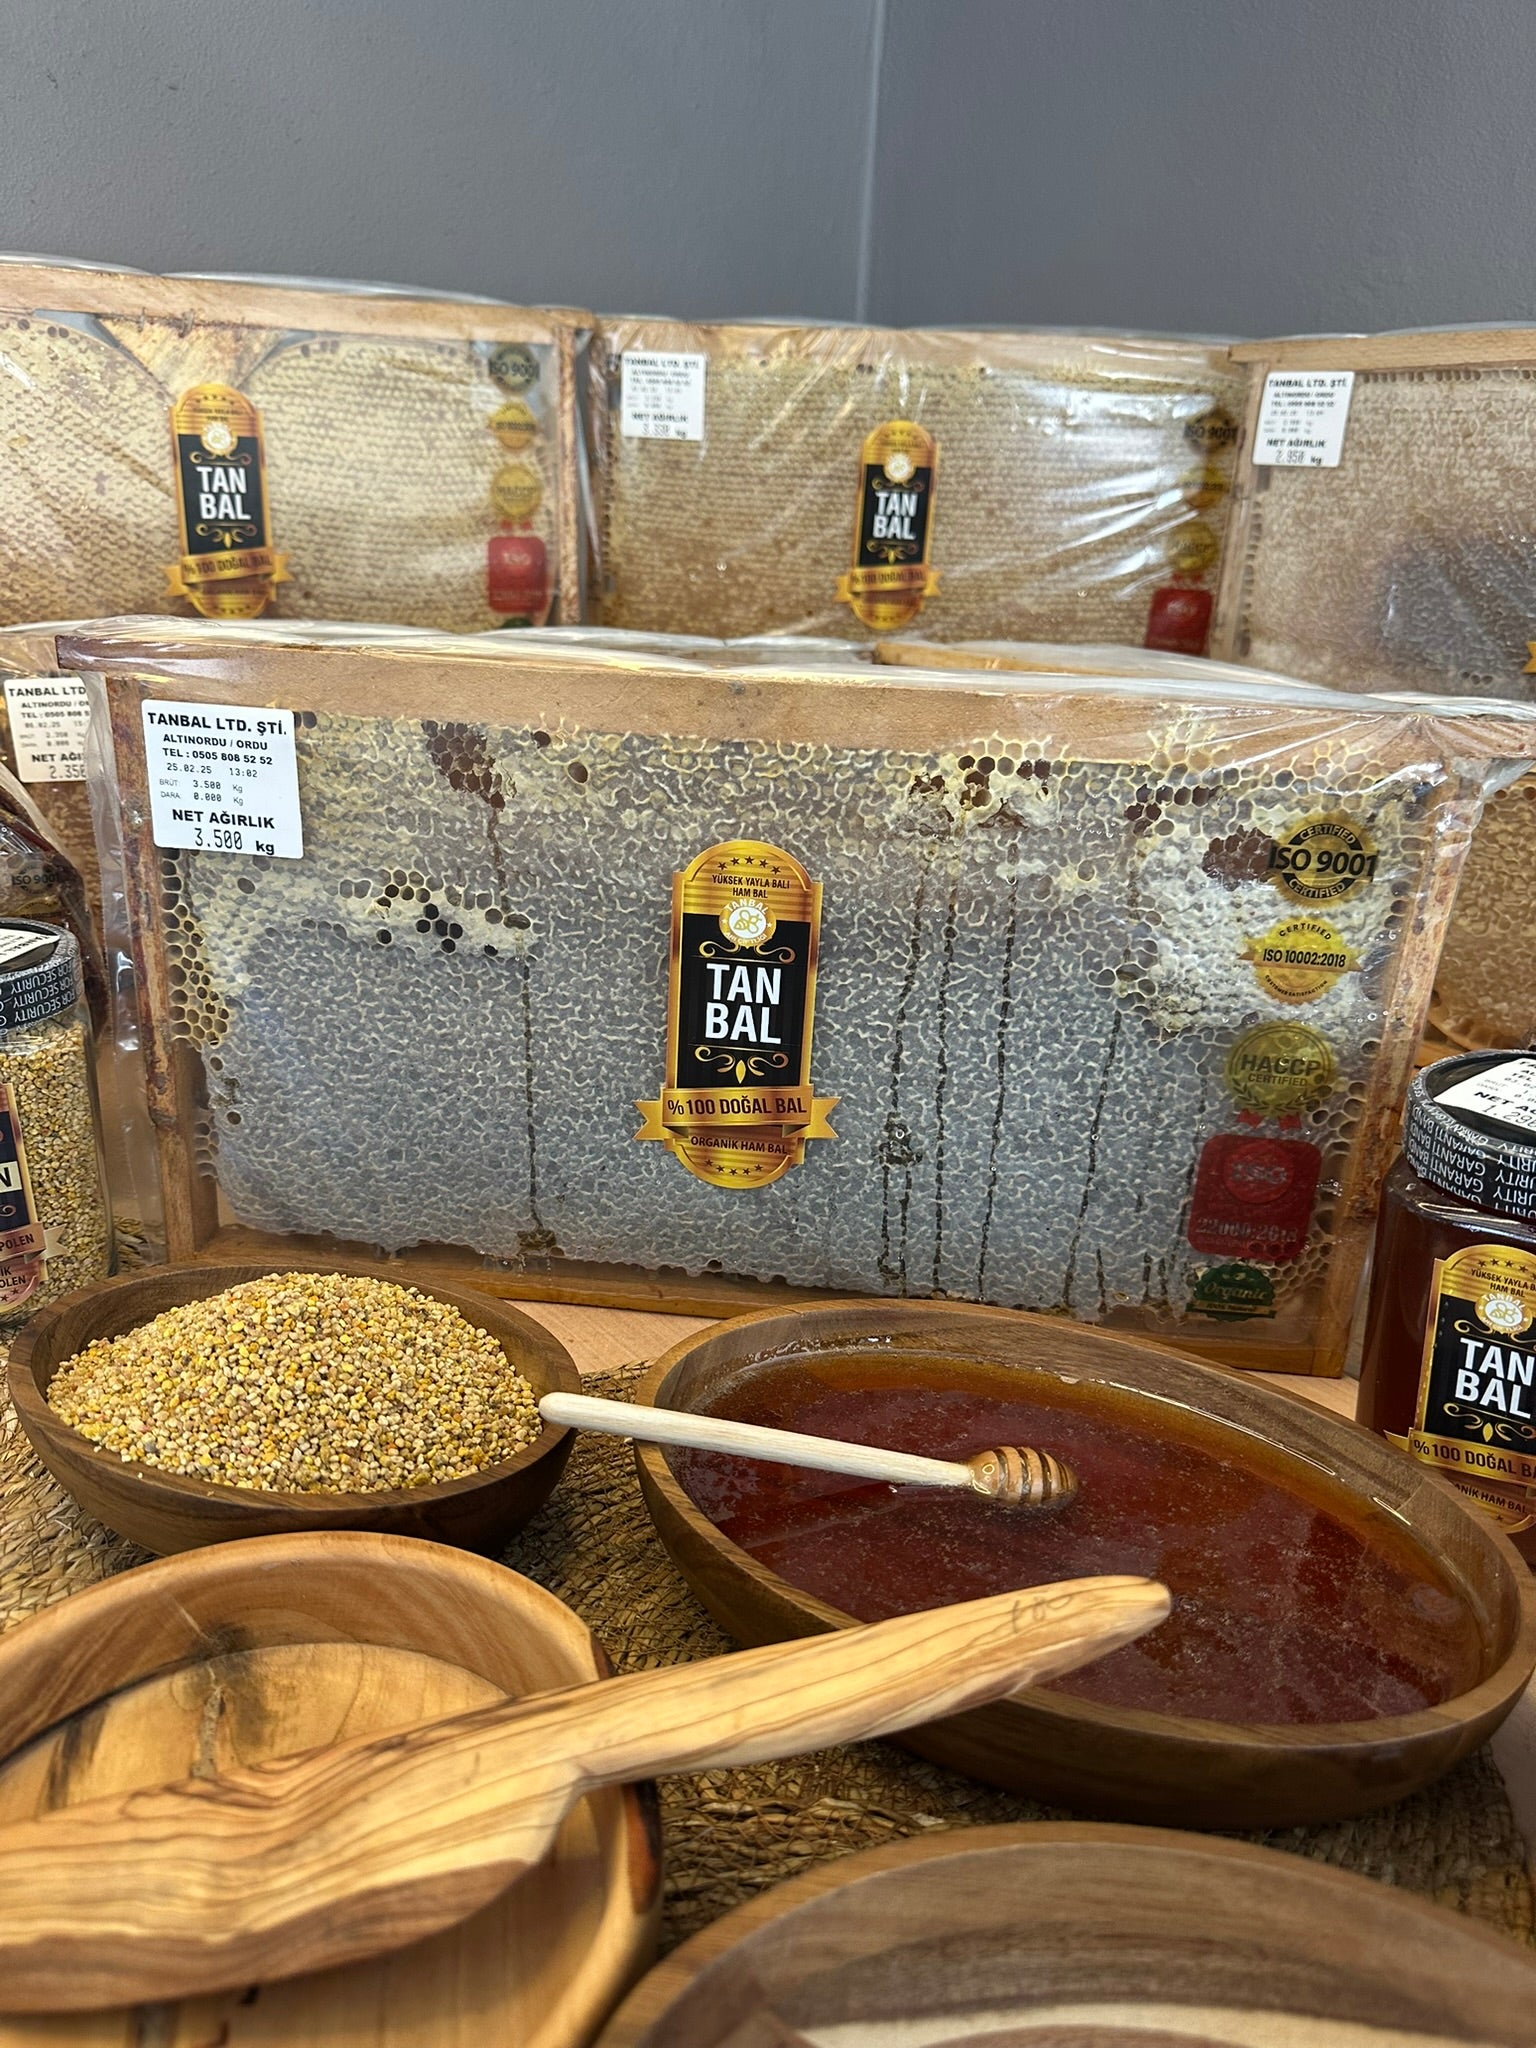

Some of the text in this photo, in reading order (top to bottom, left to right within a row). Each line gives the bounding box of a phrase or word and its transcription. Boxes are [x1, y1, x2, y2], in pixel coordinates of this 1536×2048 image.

[196, 466, 247, 494] TAN
[199, 492, 251, 520] BAL
[875, 491, 918, 517] TAN
[872, 515, 917, 540] BAL
[9, 687, 59, 697] TANBAL
[148, 712, 287, 736] TANBAL LTD. ŞTİ.
[163, 733, 227, 747] ALTINORDU
[236, 739, 268, 750] ORDU
[32, 754, 56, 762] NET
[162, 747, 183, 758] TEL
[192, 750, 218, 761] 0505
[221, 753, 240, 762] 808
[243, 754, 256, 764] 52
[259, 756, 273, 766] 52
[167, 762, 258, 778] 25.02.25 13:02
[193, 779, 221, 790] 3.500
[193, 791, 222, 802] 0.000
[172, 809, 275, 829] NET AĞIRLIK
[194, 827, 275, 856] 3.500 kg
[1300, 823, 1356, 844] CERTIFIED
[1267, 845, 1379, 877] ISO 9001
[12, 874, 32, 886] ISO
[711, 872, 790, 890] YÜKSEK YAYLA BALI
[1288, 877, 1346, 899] CERTIFIED
[732, 887, 768, 898] HAM BAL
[724, 898, 769, 915] TANBAL
[1278, 922, 1332, 940] CERTIFIED
[1262, 948, 1347, 968] ISO 10002:2018
[11, 968, 57, 995] SECURITY
[706, 962, 782, 1005] TAN
[13, 982, 60, 1009] SECURITY
[62, 989, 76, 1005] FOR
[15, 997, 62, 1023] SECURITY
[705, 1002, 782, 1045] BAL
[1241, 1054, 1321, 1077] HACCP
[1247, 1073, 1308, 1087] CERTIFIED
[667, 1095, 807, 1116] %100 DOĞAL BAL
[1474, 1091, 1515, 1105] NET
[690, 1135, 788, 1155] ORGANİK HAM BAL
[1471, 1268, 1502, 1283] YÜKSEK
[1504, 1276, 1529, 1290] YAYLA
[1203, 1281, 1267, 1301] Organic
[1490, 1282, 1508, 1294] HAM
[1510, 1287, 1526, 1298] BAL
[1460, 1336, 1535, 1386] TAN
[1455, 1368, 1531, 1420] BAL
[1413, 1438, 1461, 1463] %100
[1465, 1448, 1517, 1475] DOĞAL
[1481, 1491, 1505, 1507] HAM
[1507, 1501, 1527, 1514] BAL
